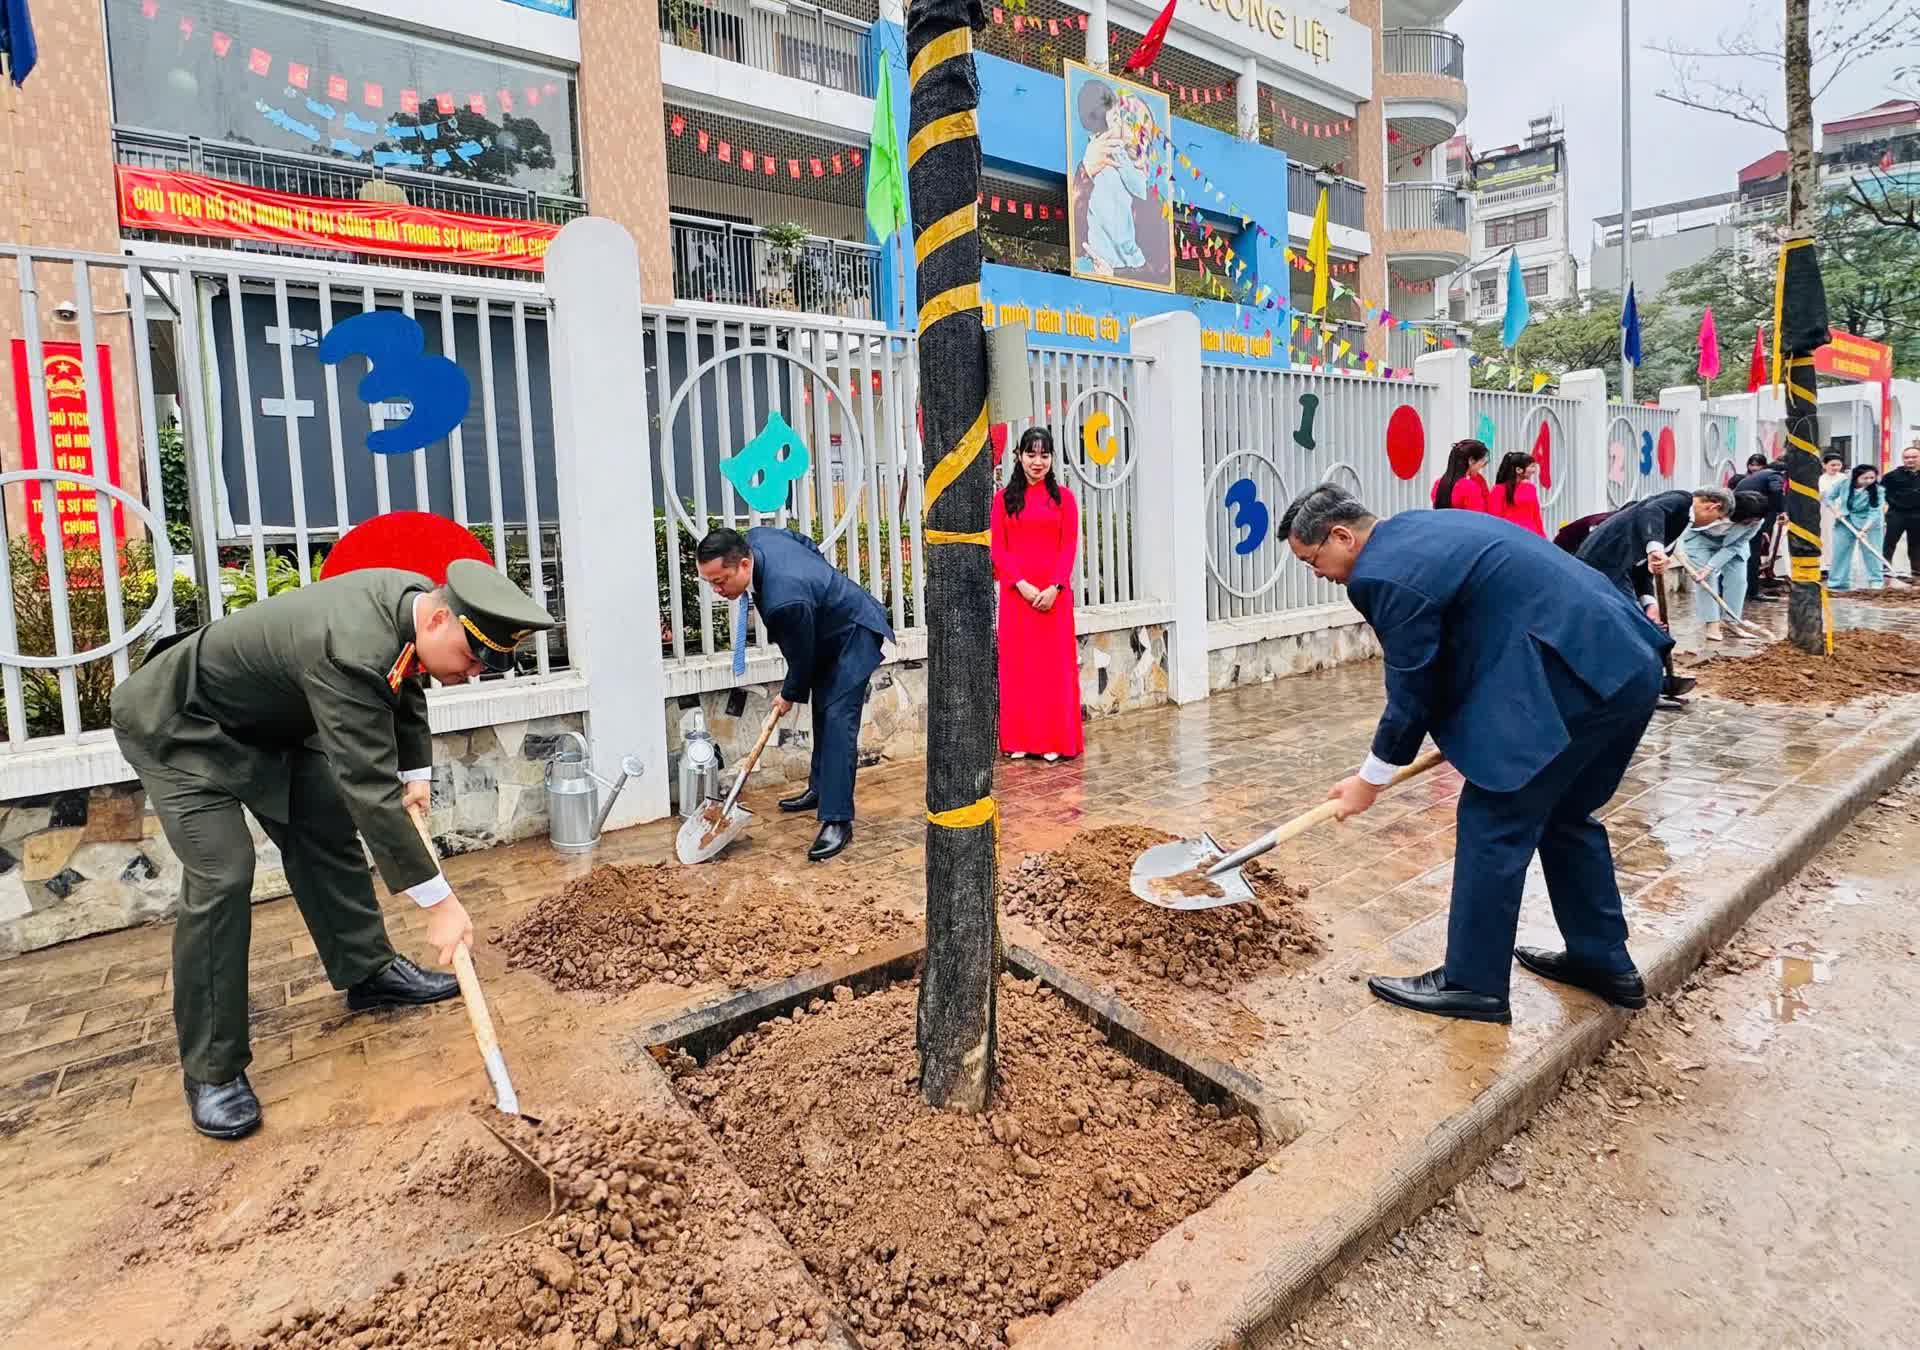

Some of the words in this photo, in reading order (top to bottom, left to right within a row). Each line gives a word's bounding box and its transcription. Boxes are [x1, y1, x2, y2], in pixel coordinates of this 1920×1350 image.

[1293, 16, 1331, 64] LIỆT
[133, 182, 165, 213] CHỦ
[168, 191, 201, 221] TỊCH
[228, 199, 253, 225] CHÍ
[255, 204, 293, 229] MINH
[312, 211, 335, 239] ĐẠI
[337, 211, 372, 238] SỐNG
[374, 217, 400, 241] MÃI
[401, 222, 441, 247] TRONG
[443, 225, 459, 255] SỰ
[461, 229, 500, 258] NGHIỆP
[504, 230, 525, 255] CỦA
[1036, 304, 1061, 334] năm
[1065, 304, 1097, 342] trồng
[1099, 312, 1119, 343] cây
[319, 311, 471, 454] 3
[55, 432, 72, 448] CHÍ
[63, 518, 97, 534] CHÚNG
[67, 498, 80, 515] SỰ
[1225, 478, 1269, 555] 3
